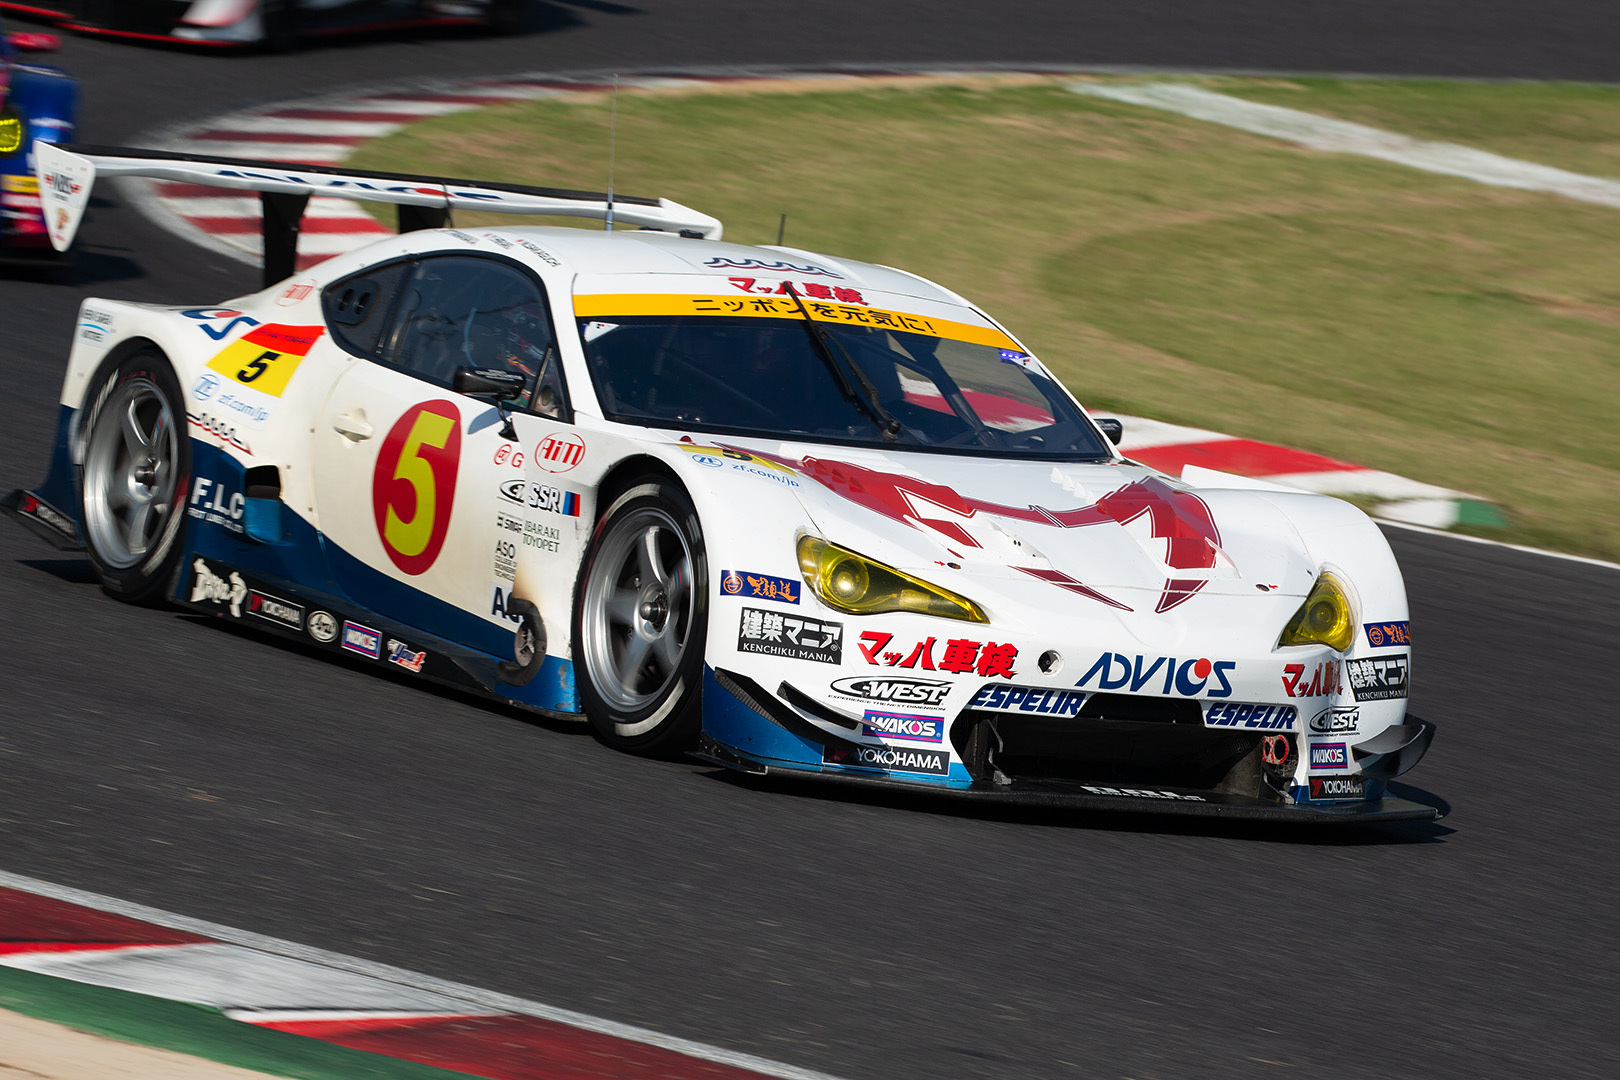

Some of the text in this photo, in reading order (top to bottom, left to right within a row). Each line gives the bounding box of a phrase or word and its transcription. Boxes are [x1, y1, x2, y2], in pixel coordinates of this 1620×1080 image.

[237, 350, 281, 383] 5
[384, 409, 456, 557] 5
[529, 482, 561, 514] SSR
[522, 532, 561, 553] TOYOPET
[524, 520, 560, 540] IBARAKI
[740, 609, 842, 649] 建築マニア
[743, 642, 834, 663] KENCHIKU MANIA
[974, 687, 1083, 716] ESPELIR
[1206, 703, 1297, 729] ESPELIR
[857, 747, 942, 770] YOKOHAMA
